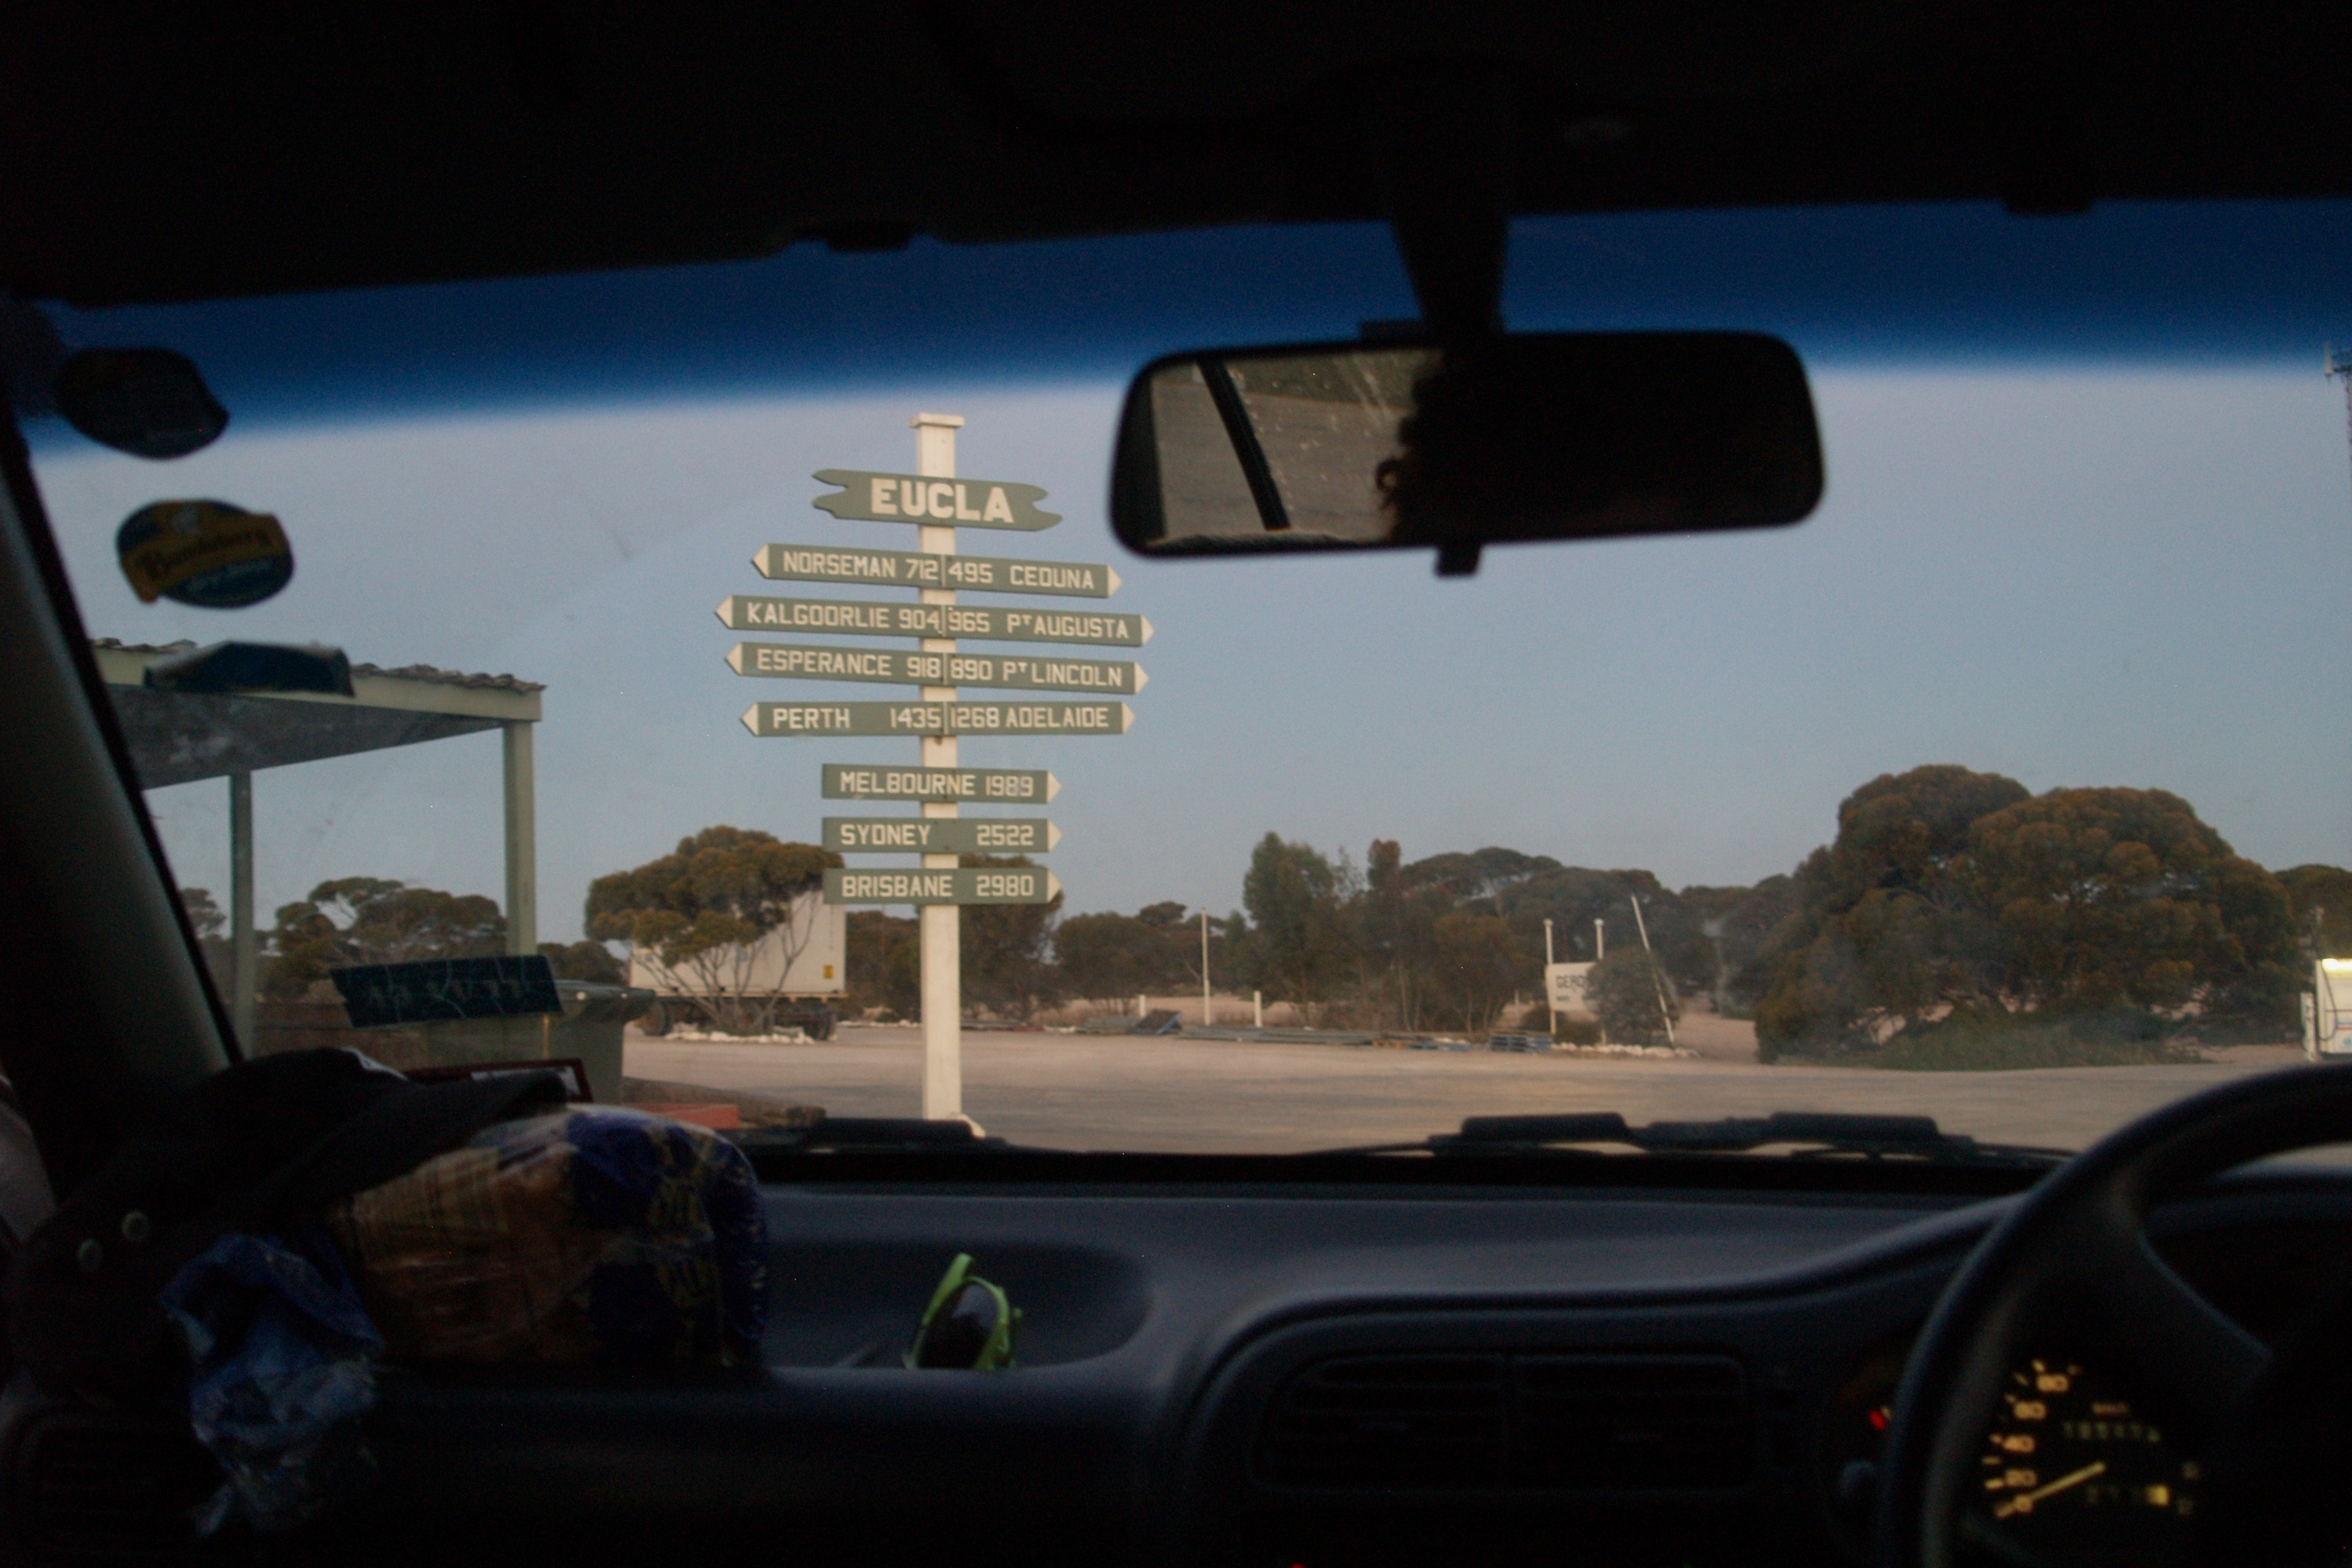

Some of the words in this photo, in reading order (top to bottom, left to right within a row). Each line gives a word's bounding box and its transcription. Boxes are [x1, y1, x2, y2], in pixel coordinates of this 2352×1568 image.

[871, 477, 1014, 524] EUCLA
[783, 549, 895, 578] NORSEMAN
[905, 559, 939, 581] 712
[948, 564, 993, 584] 495
[1010, 565, 1095, 590] CEDUNA
[747, 601, 890, 629] KALGOORLIE
[899, 607, 939, 632] 904
[948, 610, 991, 633] 965
[1034, 614, 1129, 640] AUGUSTA
[757, 648, 892, 677] ESPERANCE
[906, 655, 941, 679] 918
[950, 659, 993, 681] 890
[1031, 662, 1122, 688] LINCOLN
[772, 708, 851, 729] PERTH
[890, 708, 941, 728] 1435
[951, 708, 1000, 728] 1268
[1005, 707, 1109, 728] ADELAIDE
[840, 771, 975, 796] MELBOURNE
[840, 823, 932, 846] SYDNEY
[976, 824, 1034, 846] 2522
[841, 875, 953, 898] BRISBANE
[976, 874, 1034, 897] 2980
